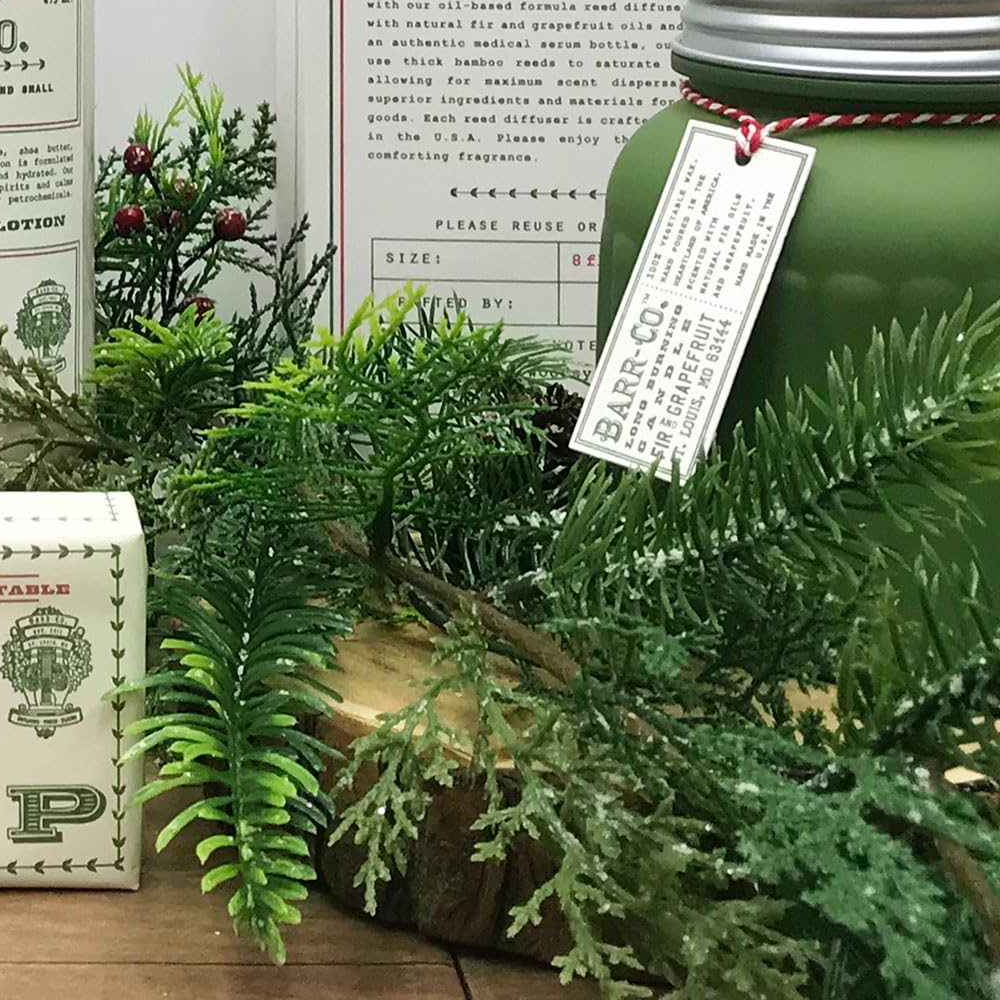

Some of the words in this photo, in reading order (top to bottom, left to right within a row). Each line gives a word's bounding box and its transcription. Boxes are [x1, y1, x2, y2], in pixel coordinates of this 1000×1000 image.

[22, 83, 54, 94] SMALL
[368, 151, 449, 163] comforting
[459, 152, 537, 163] fragrance.
[436, 220, 499, 231] PLEASE
[512, 221, 564, 232] REUSE
[578, 222, 597, 232] OR
[659, 189, 686, 249] VEGETABLE
[684, 159, 698, 186] WAX.
[386, 252, 441, 264] SIZE:
[625, 400, 647, 449] LONG
[648, 304, 682, 390] BURNING
[670, 312, 716, 417] GRAPEFRUIT
[684, 395, 706, 447] LOUIS,
[698, 366, 714, 389] MO
[706, 319, 732, 362] 63144
